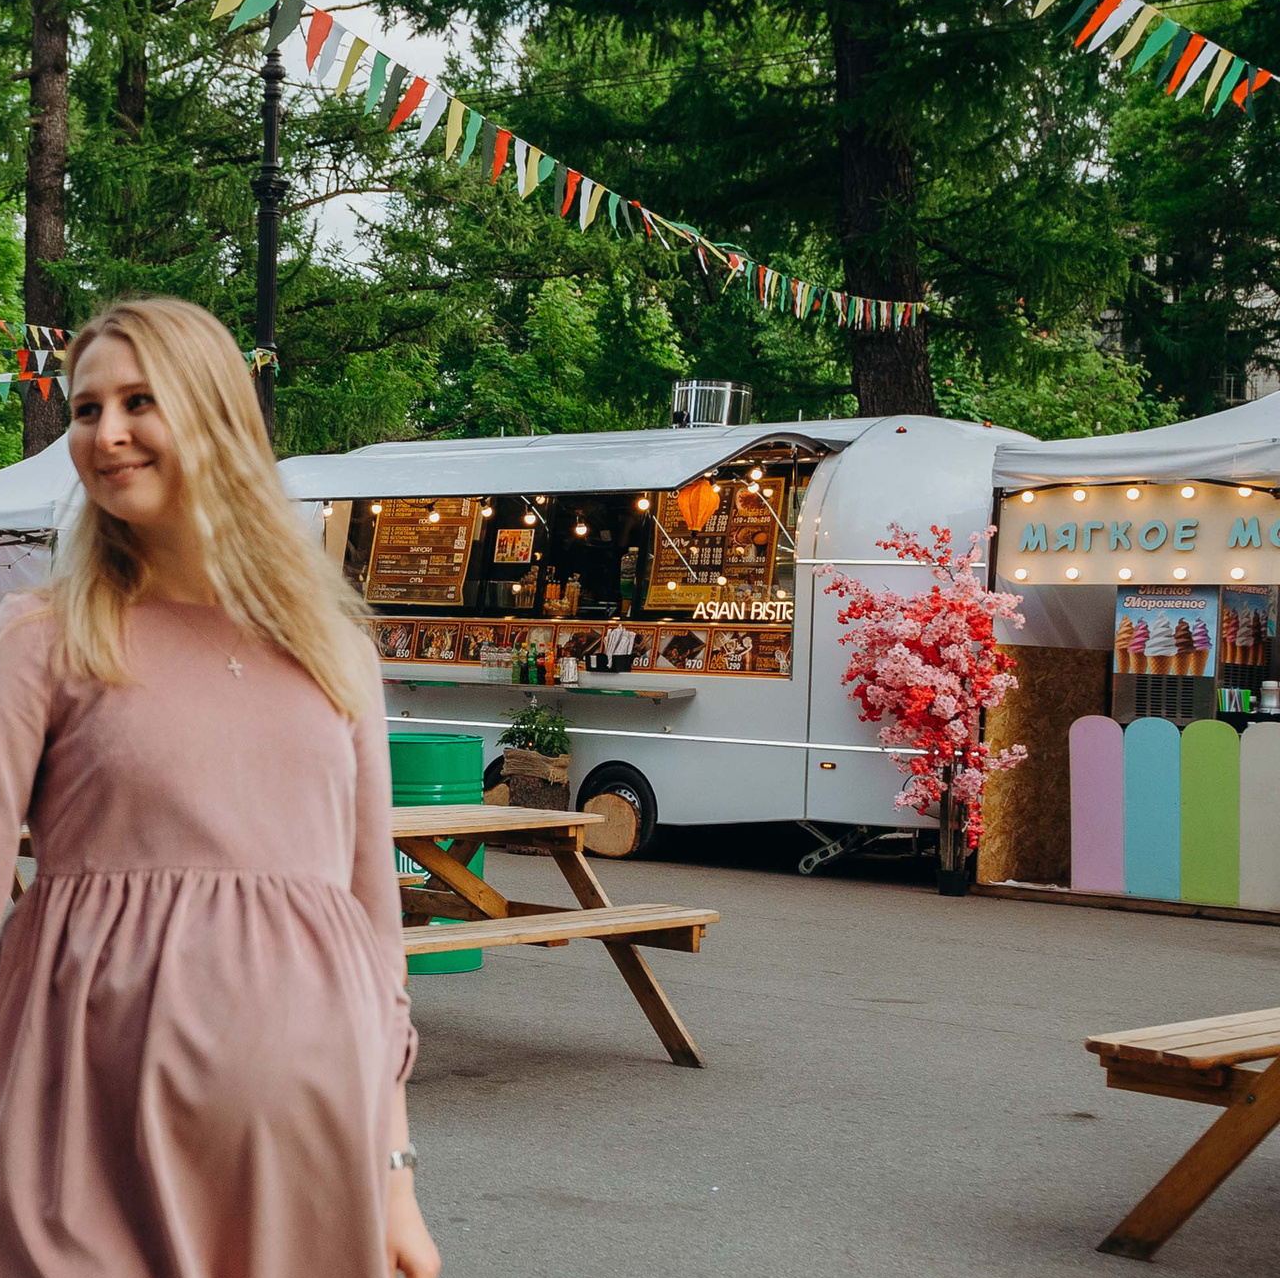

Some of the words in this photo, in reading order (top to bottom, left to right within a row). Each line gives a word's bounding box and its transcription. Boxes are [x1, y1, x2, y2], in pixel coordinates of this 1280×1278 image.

[1019, 518, 1199, 553] МЯГКОЕ
[1138, 585, 1192, 596] Мягкое
[1123, 596, 1206, 610] Мороженое
[692, 601, 745, 620] ASIAN
[396, 649, 410, 658] 650
[440, 650, 454, 660] 460
[633, 657, 649, 667] 610
[685, 658, 703, 669] 470
